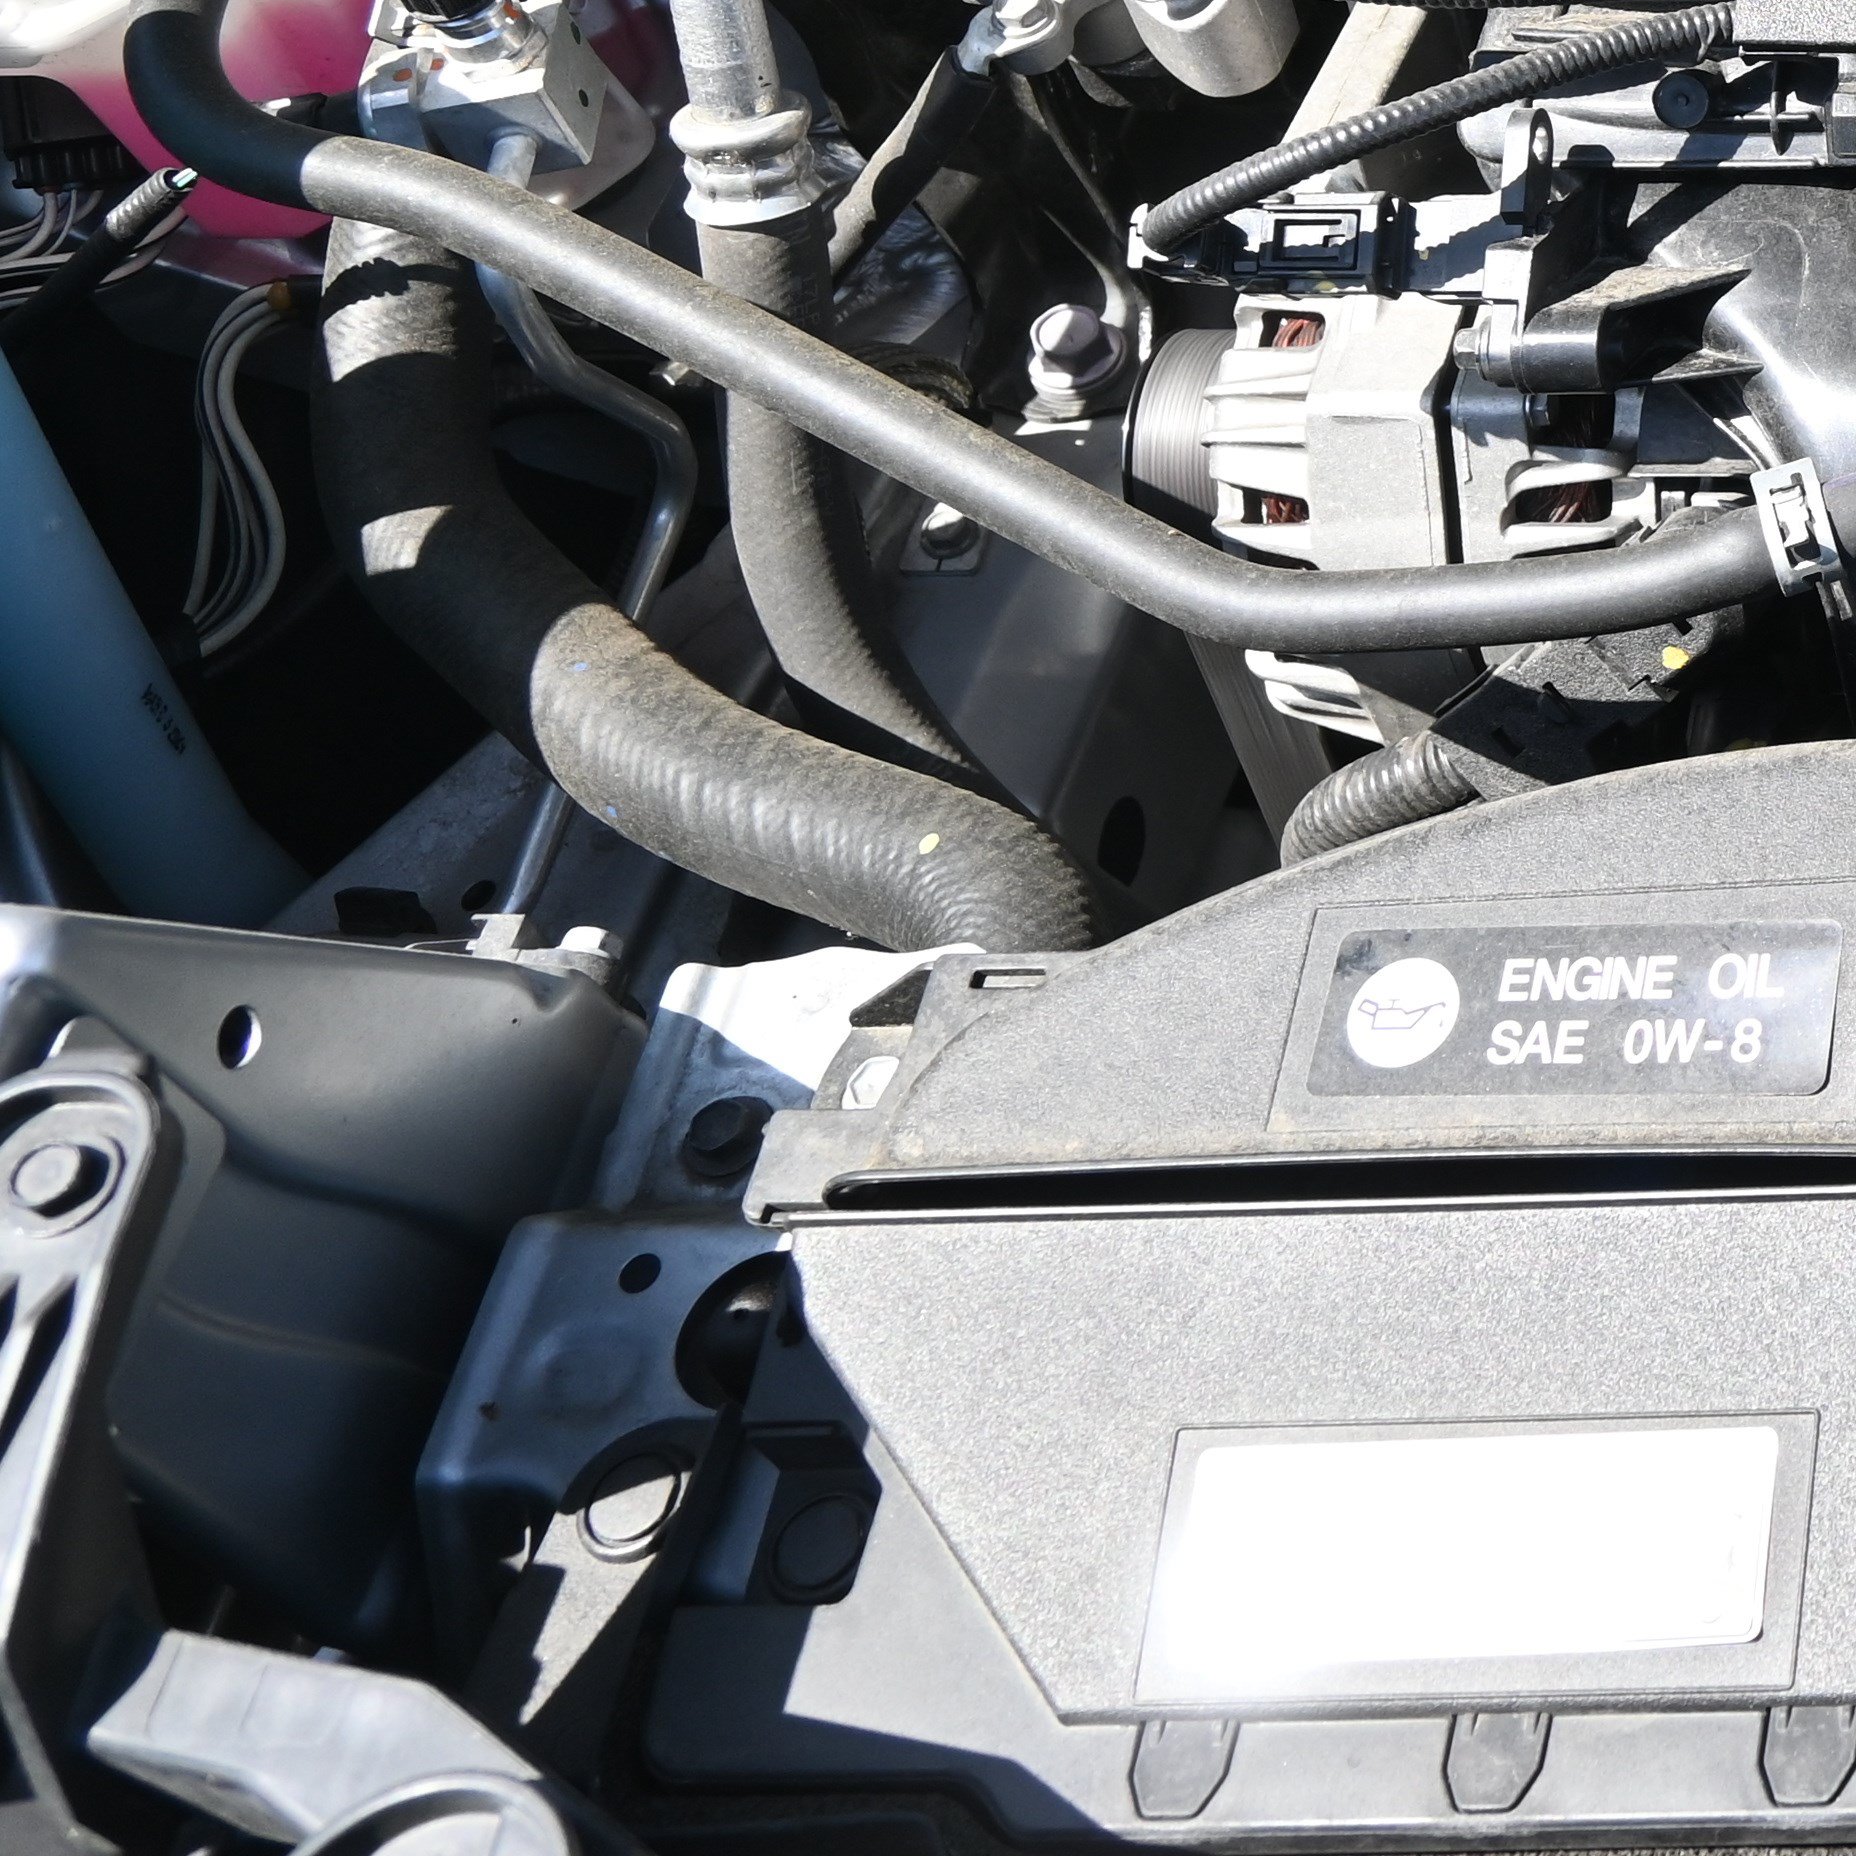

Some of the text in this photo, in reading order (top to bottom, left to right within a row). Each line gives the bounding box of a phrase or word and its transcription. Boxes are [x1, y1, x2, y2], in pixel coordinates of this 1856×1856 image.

[1496, 952, 1785, 1003] ENGINE OIL
[1485, 1017, 1764, 1066] SAE 0W-8
